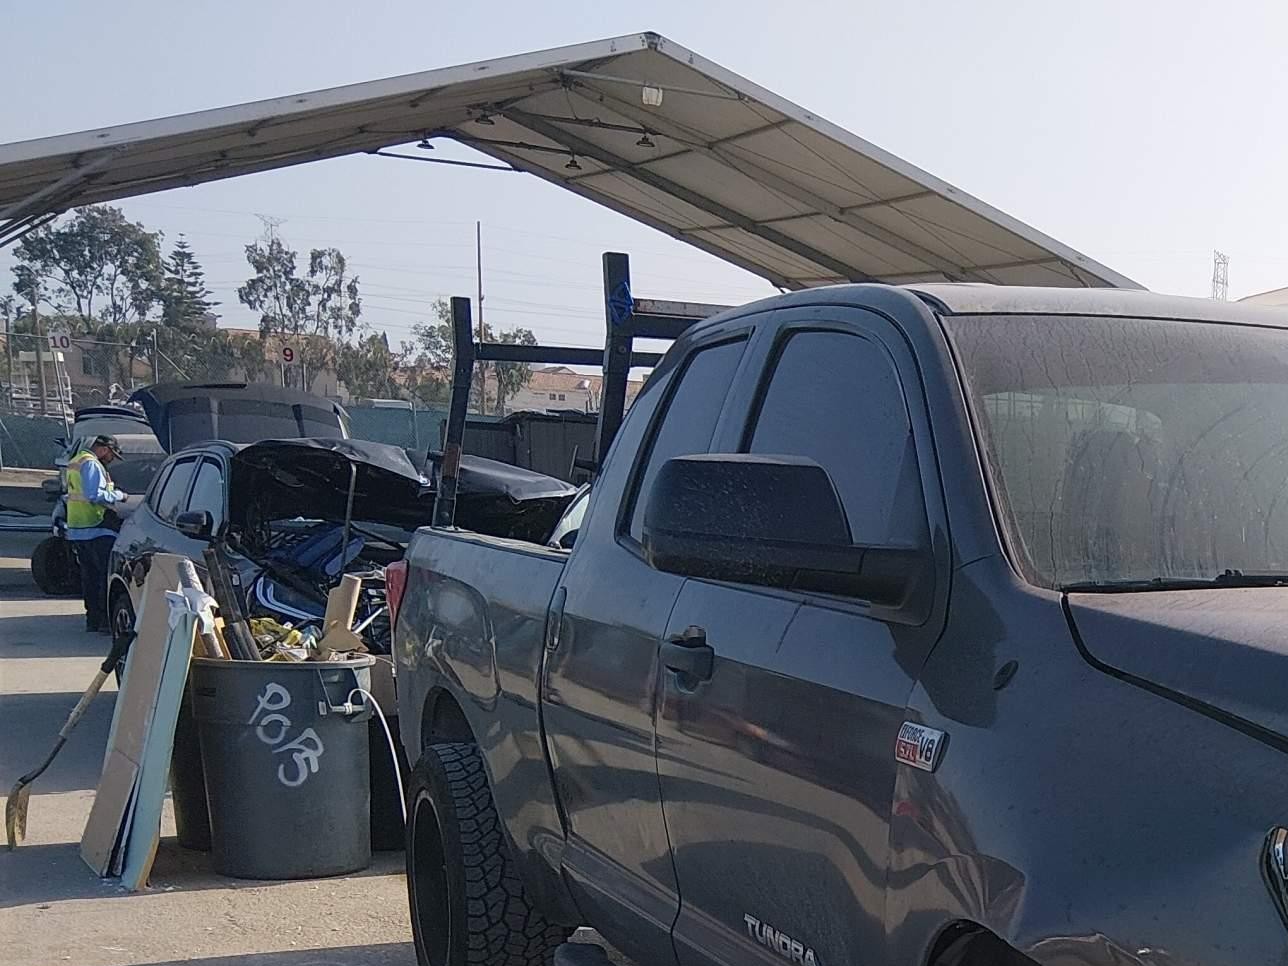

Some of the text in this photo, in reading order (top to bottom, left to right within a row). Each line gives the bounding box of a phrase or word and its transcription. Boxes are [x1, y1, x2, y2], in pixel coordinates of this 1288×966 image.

[50, 335, 70, 349] 10
[283, 347, 294, 362] 9
[919, 736, 936, 762] V8
